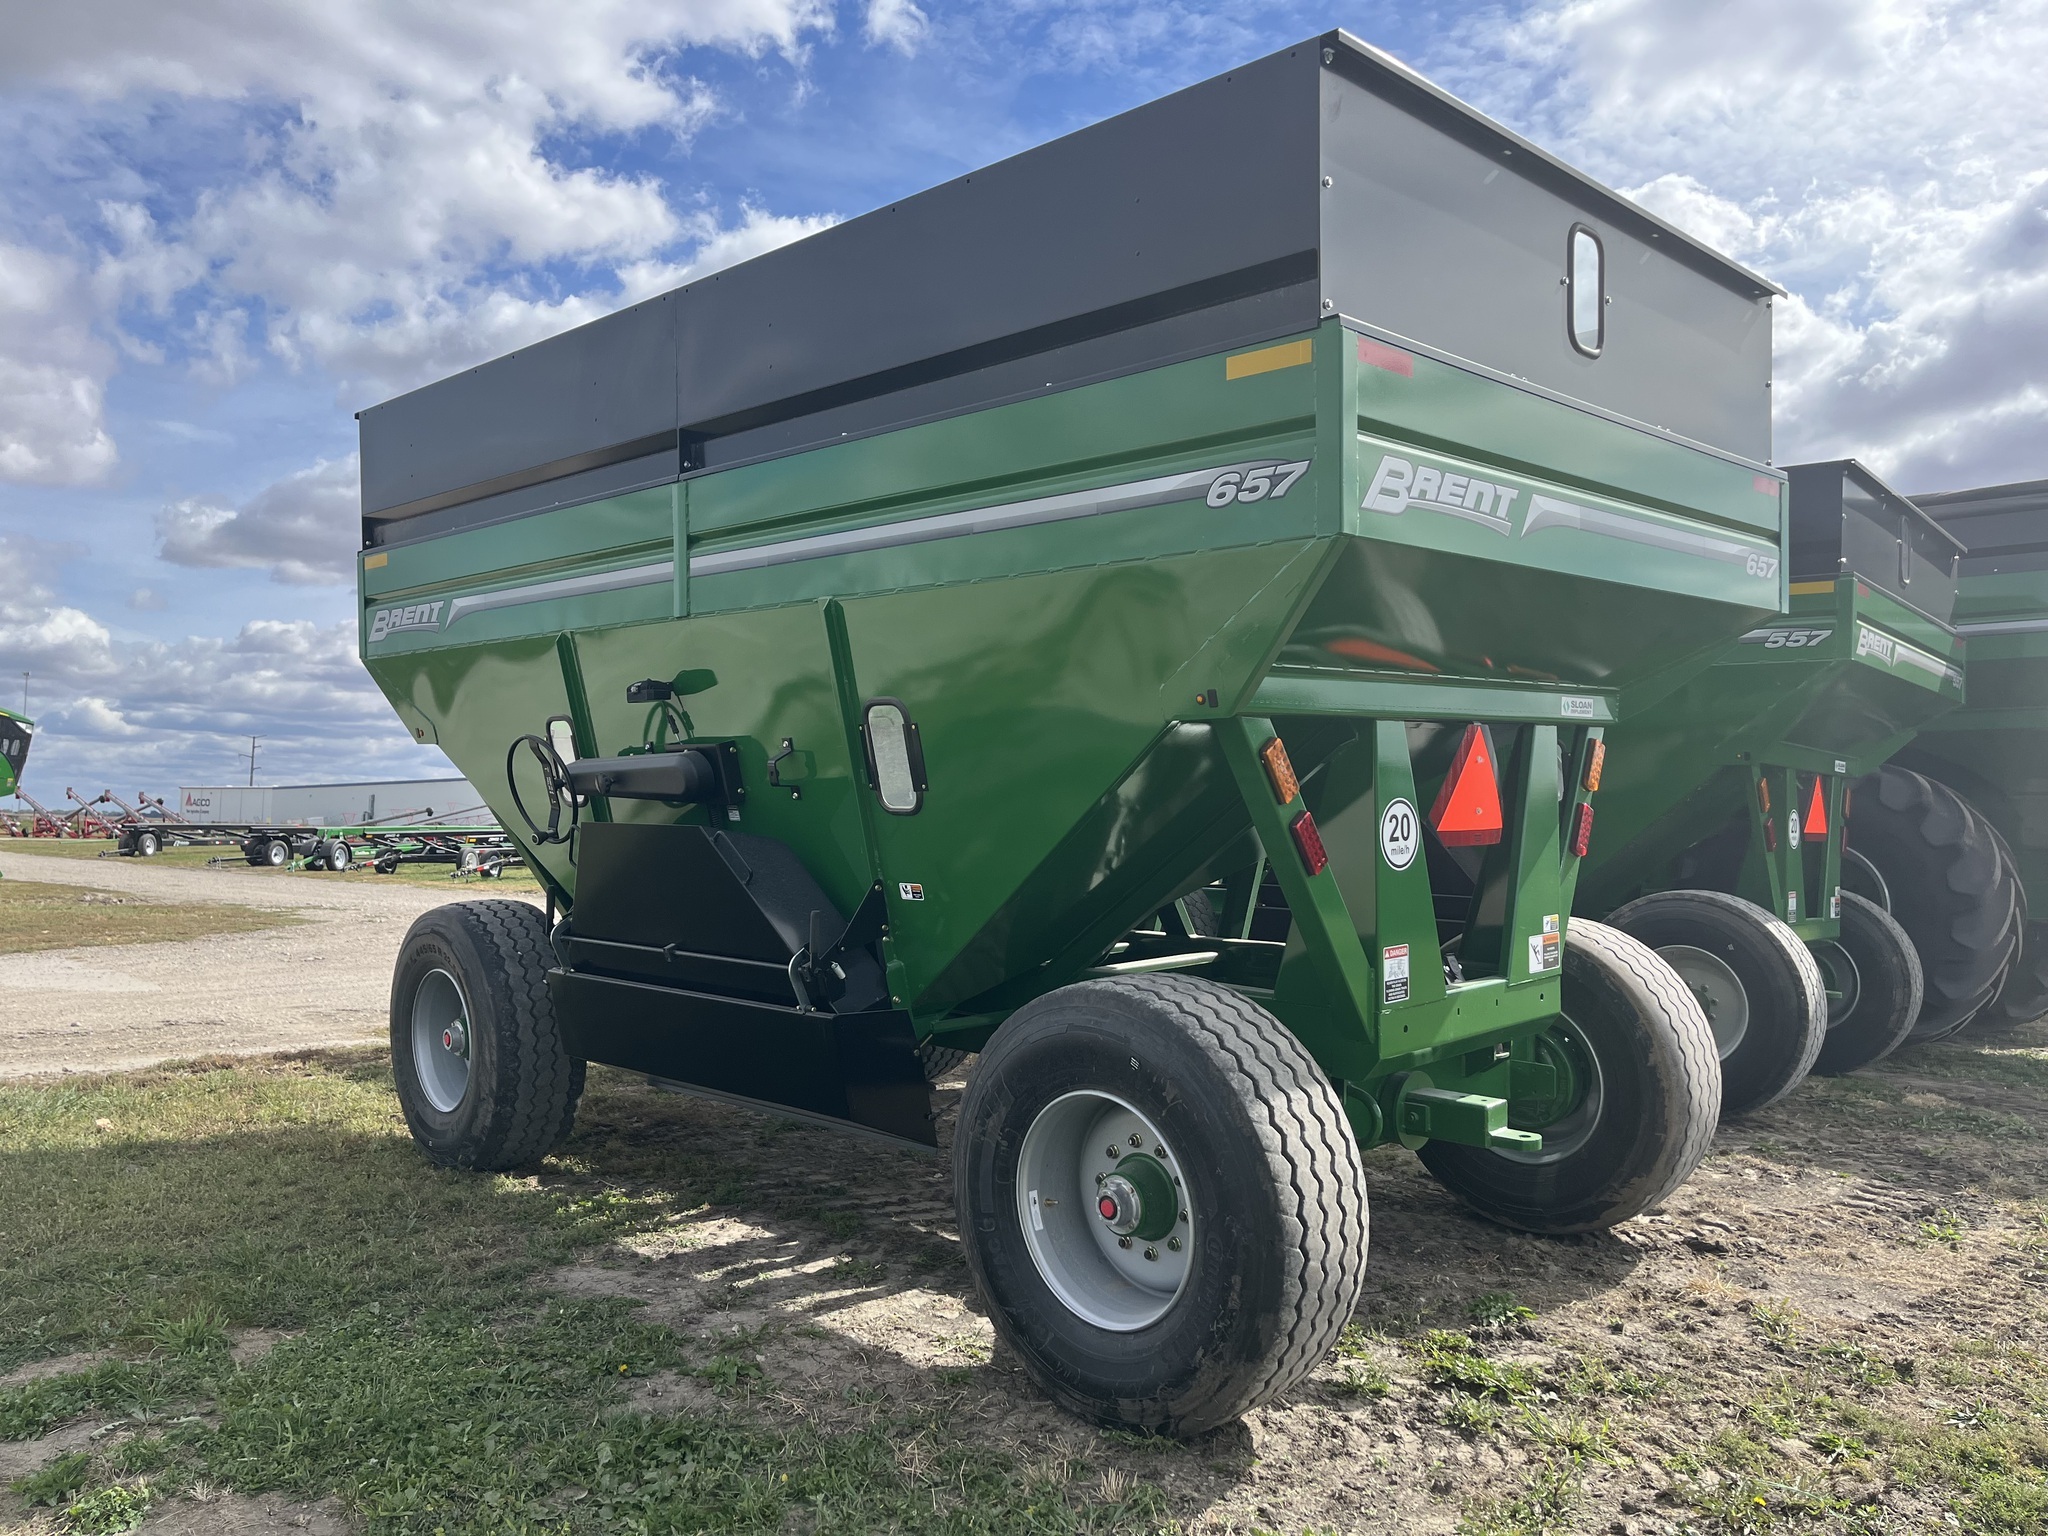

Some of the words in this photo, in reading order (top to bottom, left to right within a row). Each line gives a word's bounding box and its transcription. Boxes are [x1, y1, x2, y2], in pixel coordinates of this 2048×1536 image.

[1206, 459, 1311, 509] 657
[1360, 455, 1519, 521] BRENT
[1746, 553, 1779, 578] 657
[367, 601, 445, 643] BRENT
[1764, 629, 1833, 649] 557
[1856, 627, 1893, 657] BRENT
[1570, 700, 1592, 709] SLOAN
[1389, 813, 1411, 842] 20
[1391, 844, 1410, 855] mile/h
